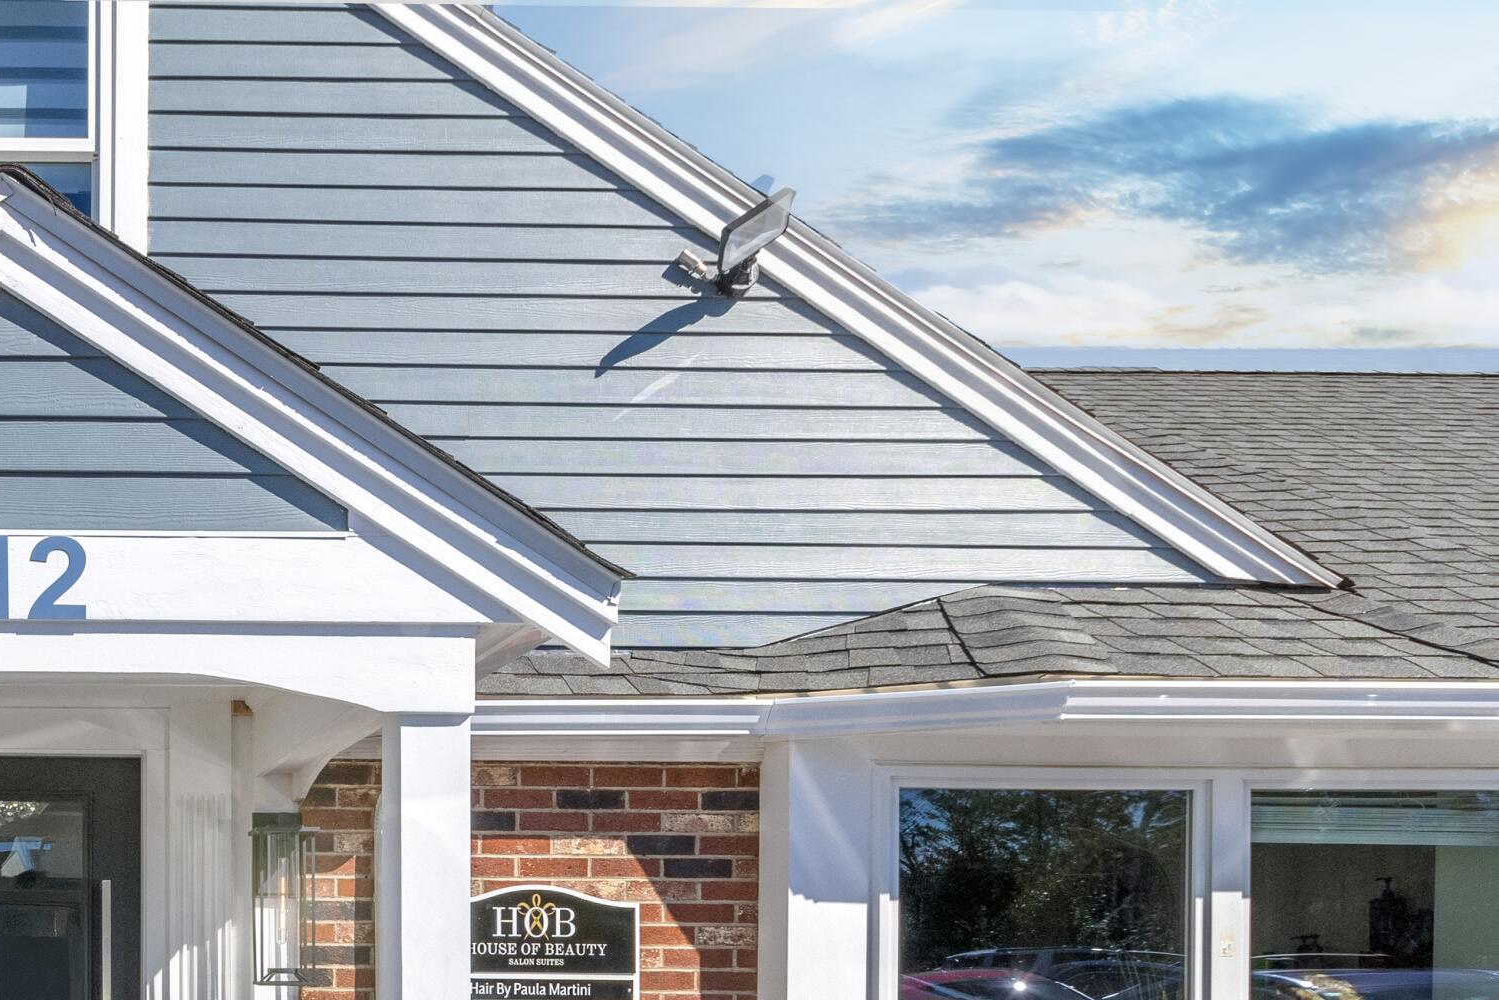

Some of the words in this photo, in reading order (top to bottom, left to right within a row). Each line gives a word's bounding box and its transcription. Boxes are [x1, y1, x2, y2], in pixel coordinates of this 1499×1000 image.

[492, 905, 577, 938] HOB
[520, 943, 541, 956] OF
[544, 943, 608, 957] BEAUTY
[508, 958, 535, 966] SALON
[536, 958, 565, 966] SUITES
[470, 982, 494, 995] Hair
[496, 982, 512, 999] By
[513, 982, 547, 996] Paula
[549, 983, 592, 996] Martini
